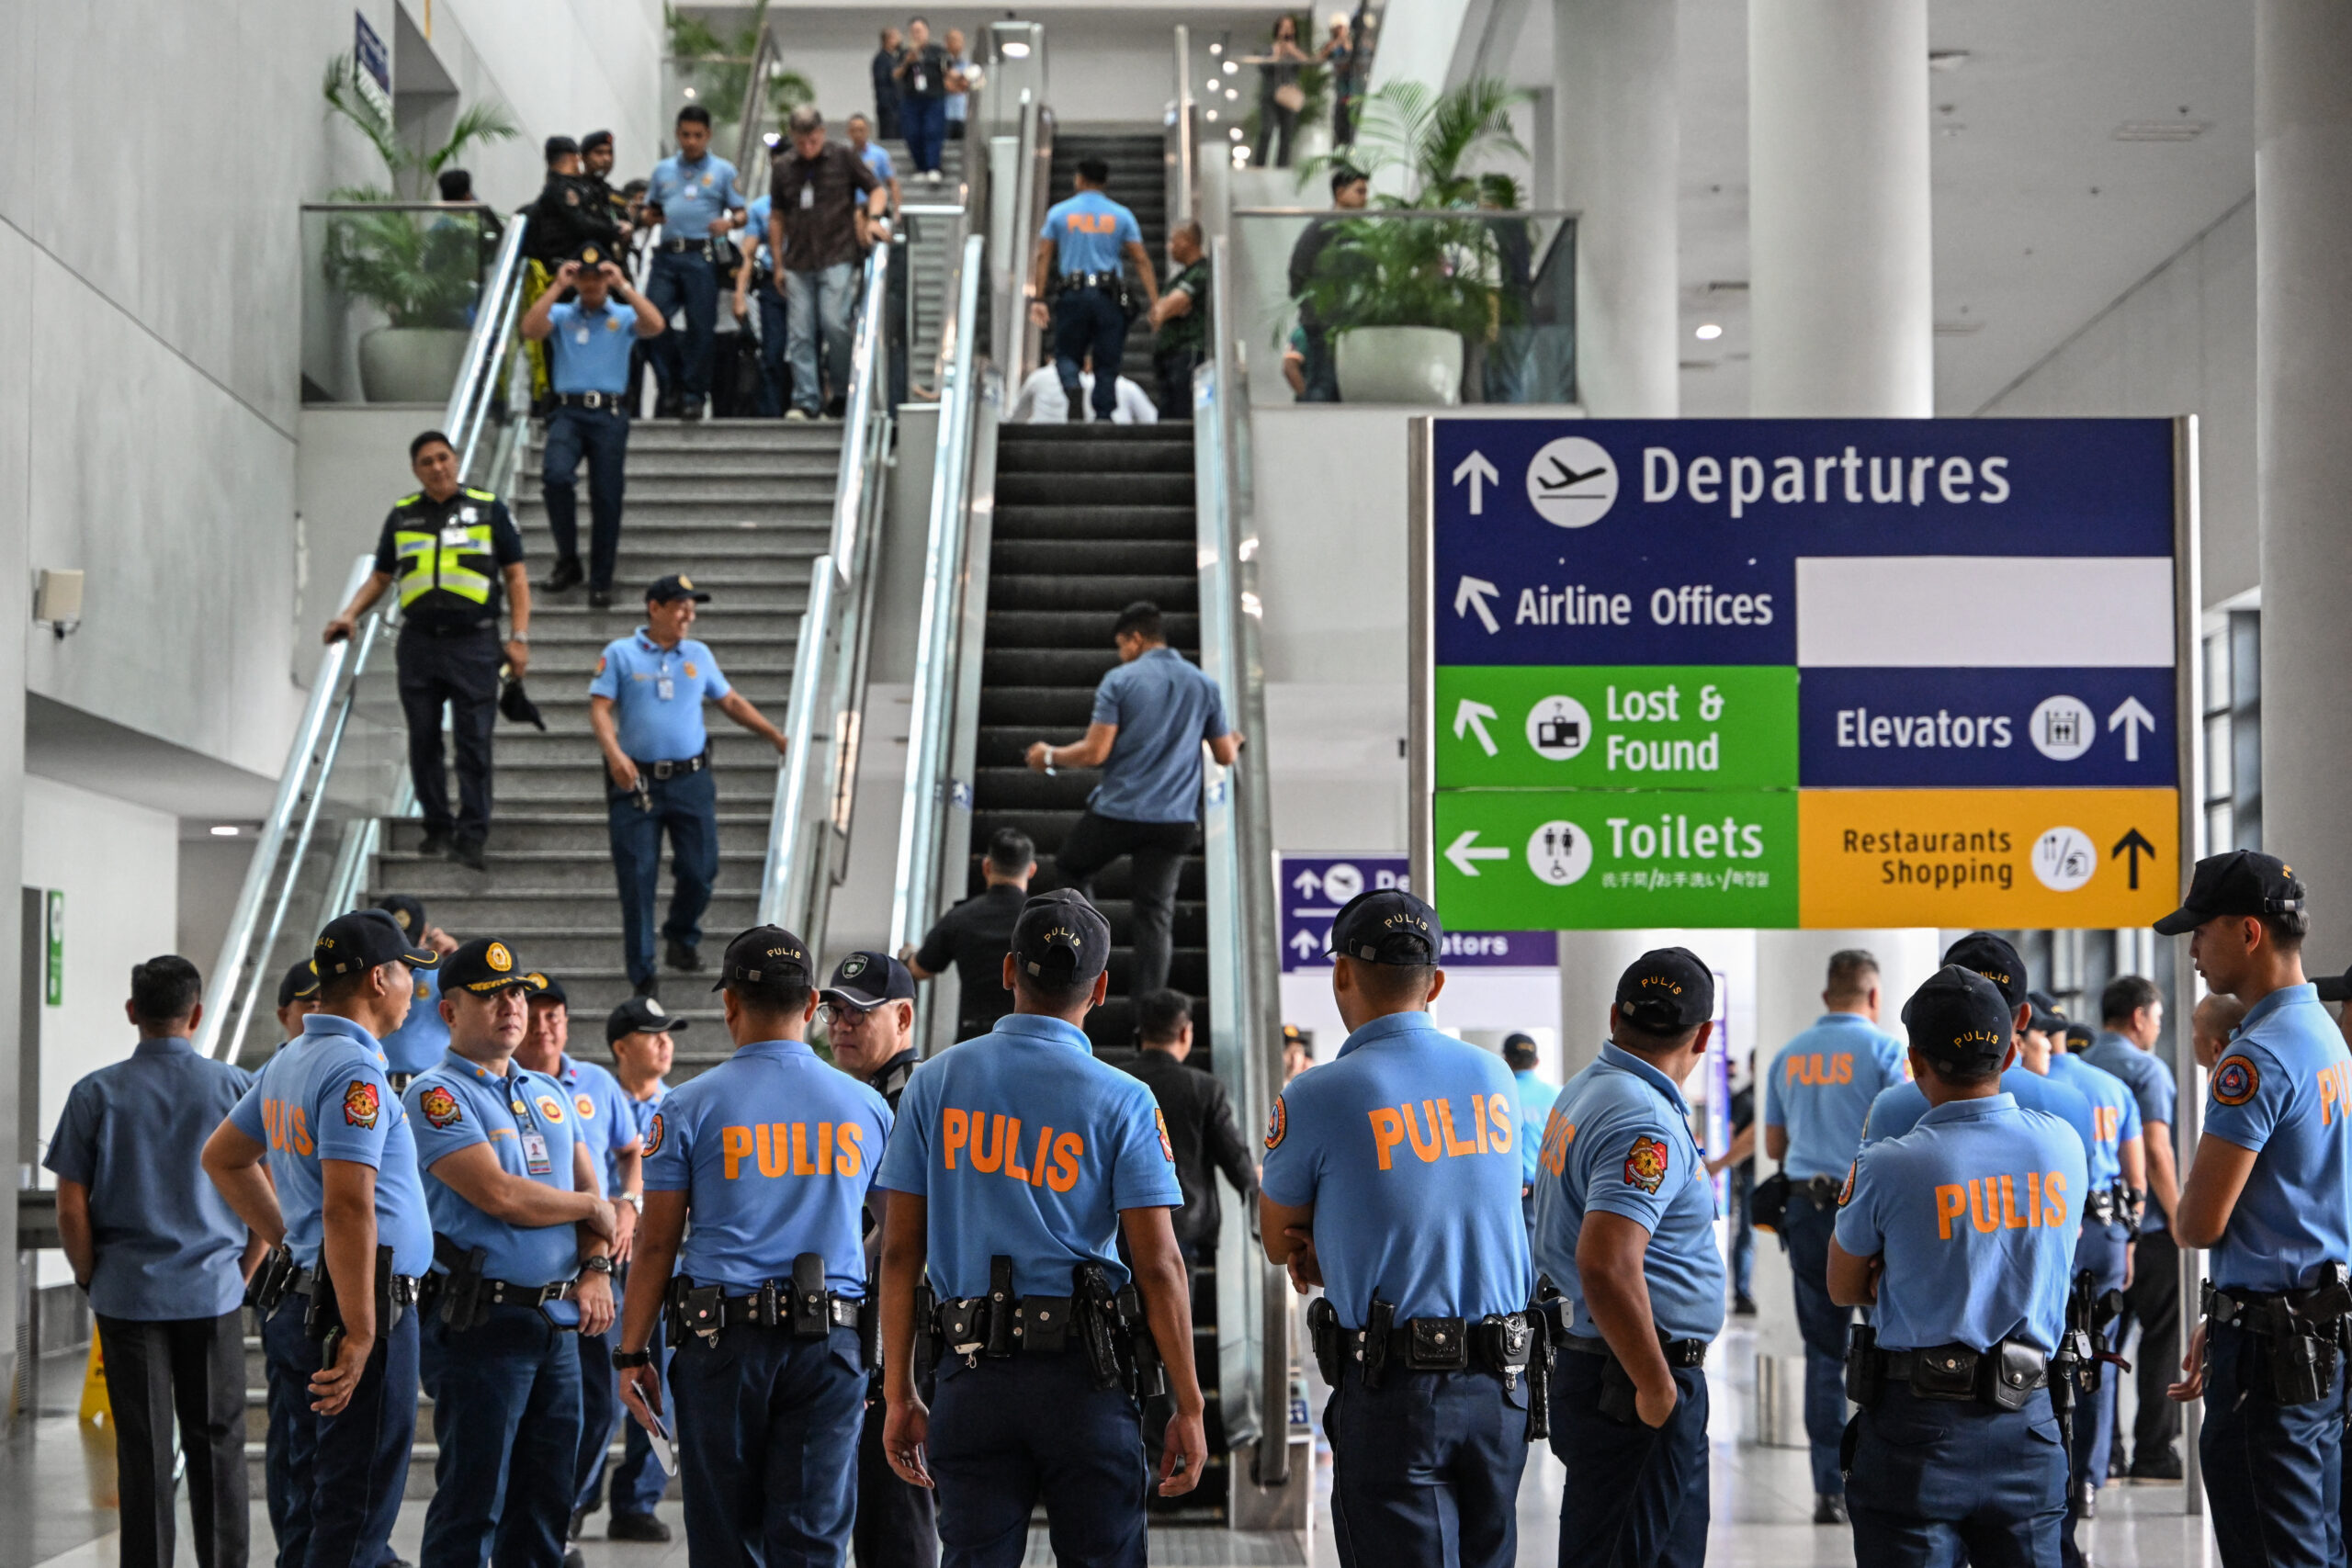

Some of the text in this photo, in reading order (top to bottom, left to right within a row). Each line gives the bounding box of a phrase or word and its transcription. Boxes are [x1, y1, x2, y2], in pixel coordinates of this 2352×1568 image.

[1644, 446, 2010, 518] Departures
[1516, 585, 1773, 626] Airline Offices
[1607, 684, 1724, 722] Lost &
[1838, 708, 2012, 748] Elevators
[1607, 732, 1719, 772] Found
[1607, 815, 1763, 859] Toilets
[1844, 829, 2011, 853] Restaurants
[1882, 859, 2013, 890] Shopping
[1044, 926, 1081, 946] PULIS
[1384, 913, 1428, 931] PULIS
[765, 947, 801, 960] PULIS
[1640, 976, 1682, 996] PULIS
[1952, 1030, 1999, 1048] PULIS
[1786, 1052, 1854, 1087] PULIS
[722, 1122, 864, 1180] PULIS
[943, 1108, 1084, 1193] PULIS
[1368, 1093, 1513, 1171] PULIS
[1935, 1170, 2067, 1240] PULIS
